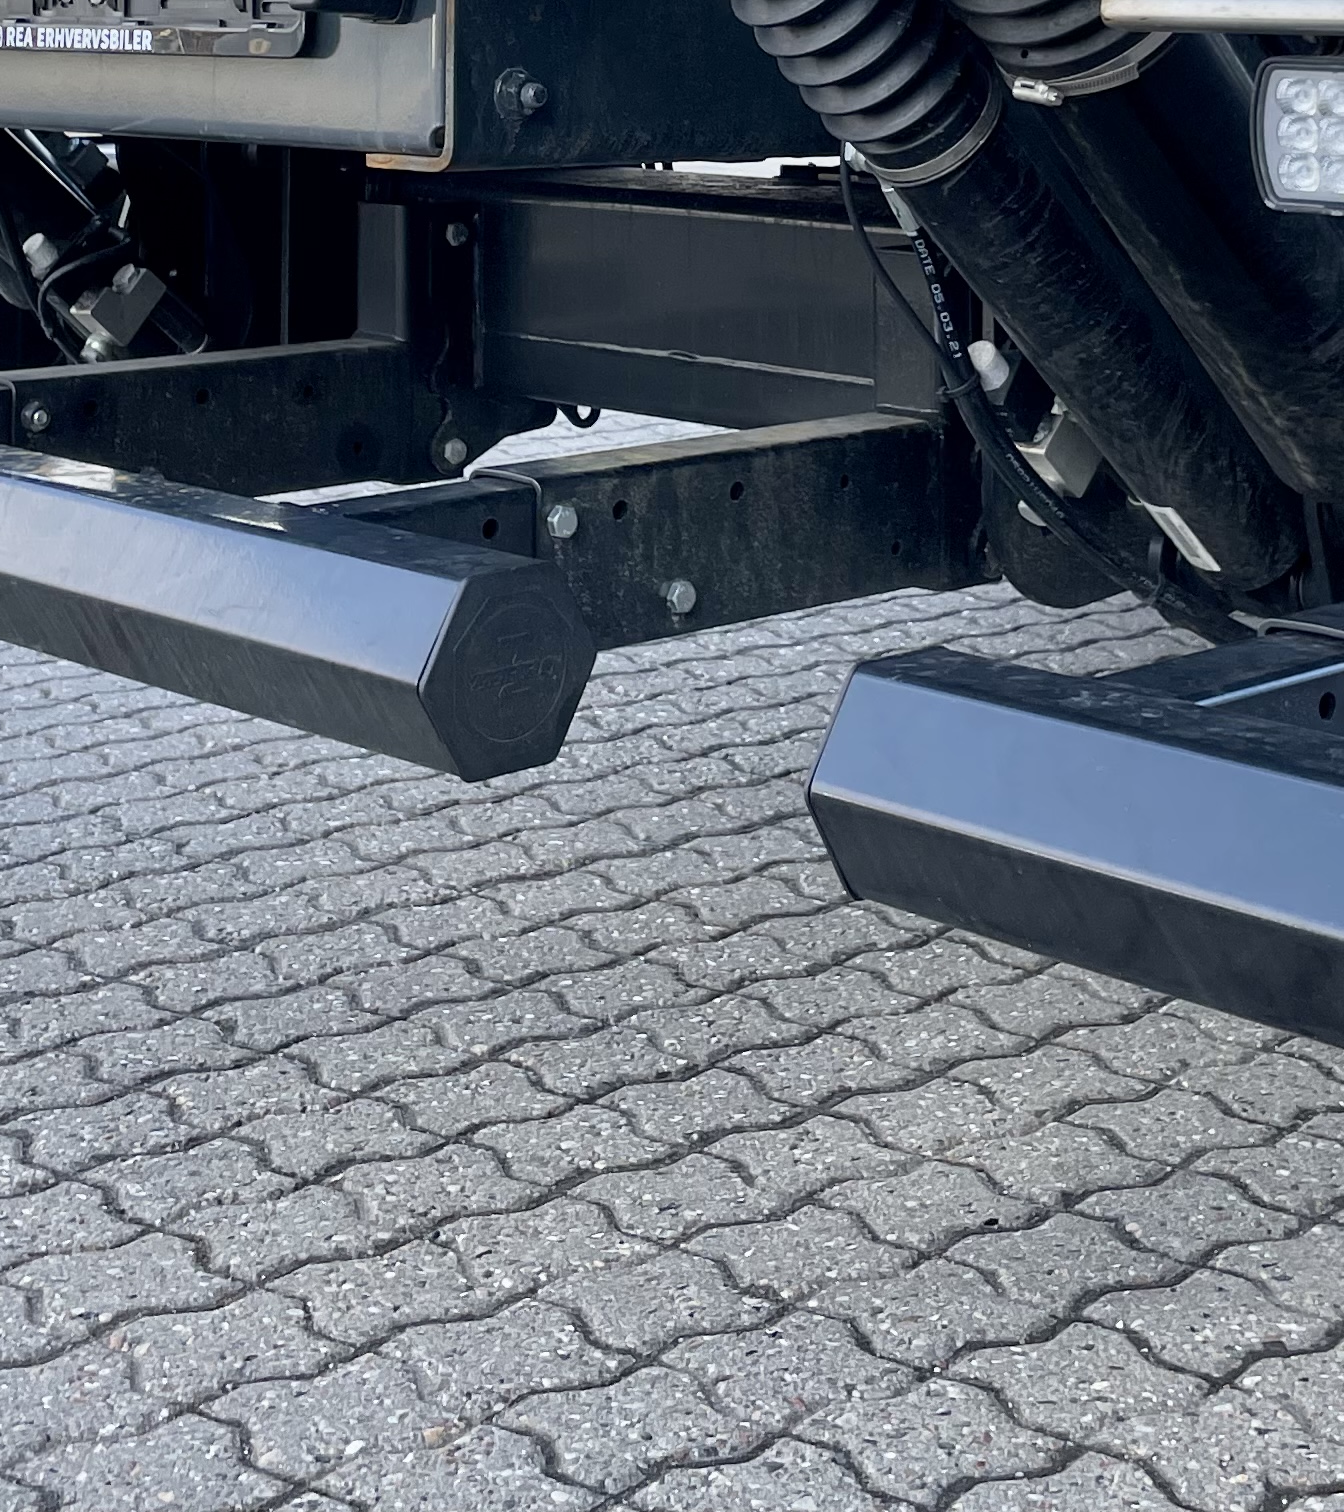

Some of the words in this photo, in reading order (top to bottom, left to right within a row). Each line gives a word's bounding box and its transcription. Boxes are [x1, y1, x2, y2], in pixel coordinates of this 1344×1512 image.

[5, 26, 33, 48] REA
[36, 27, 153, 51] ERHVERVSBILER
[914, 239, 936, 276] DATE
[930, 283, 963, 359] 05.03.21
